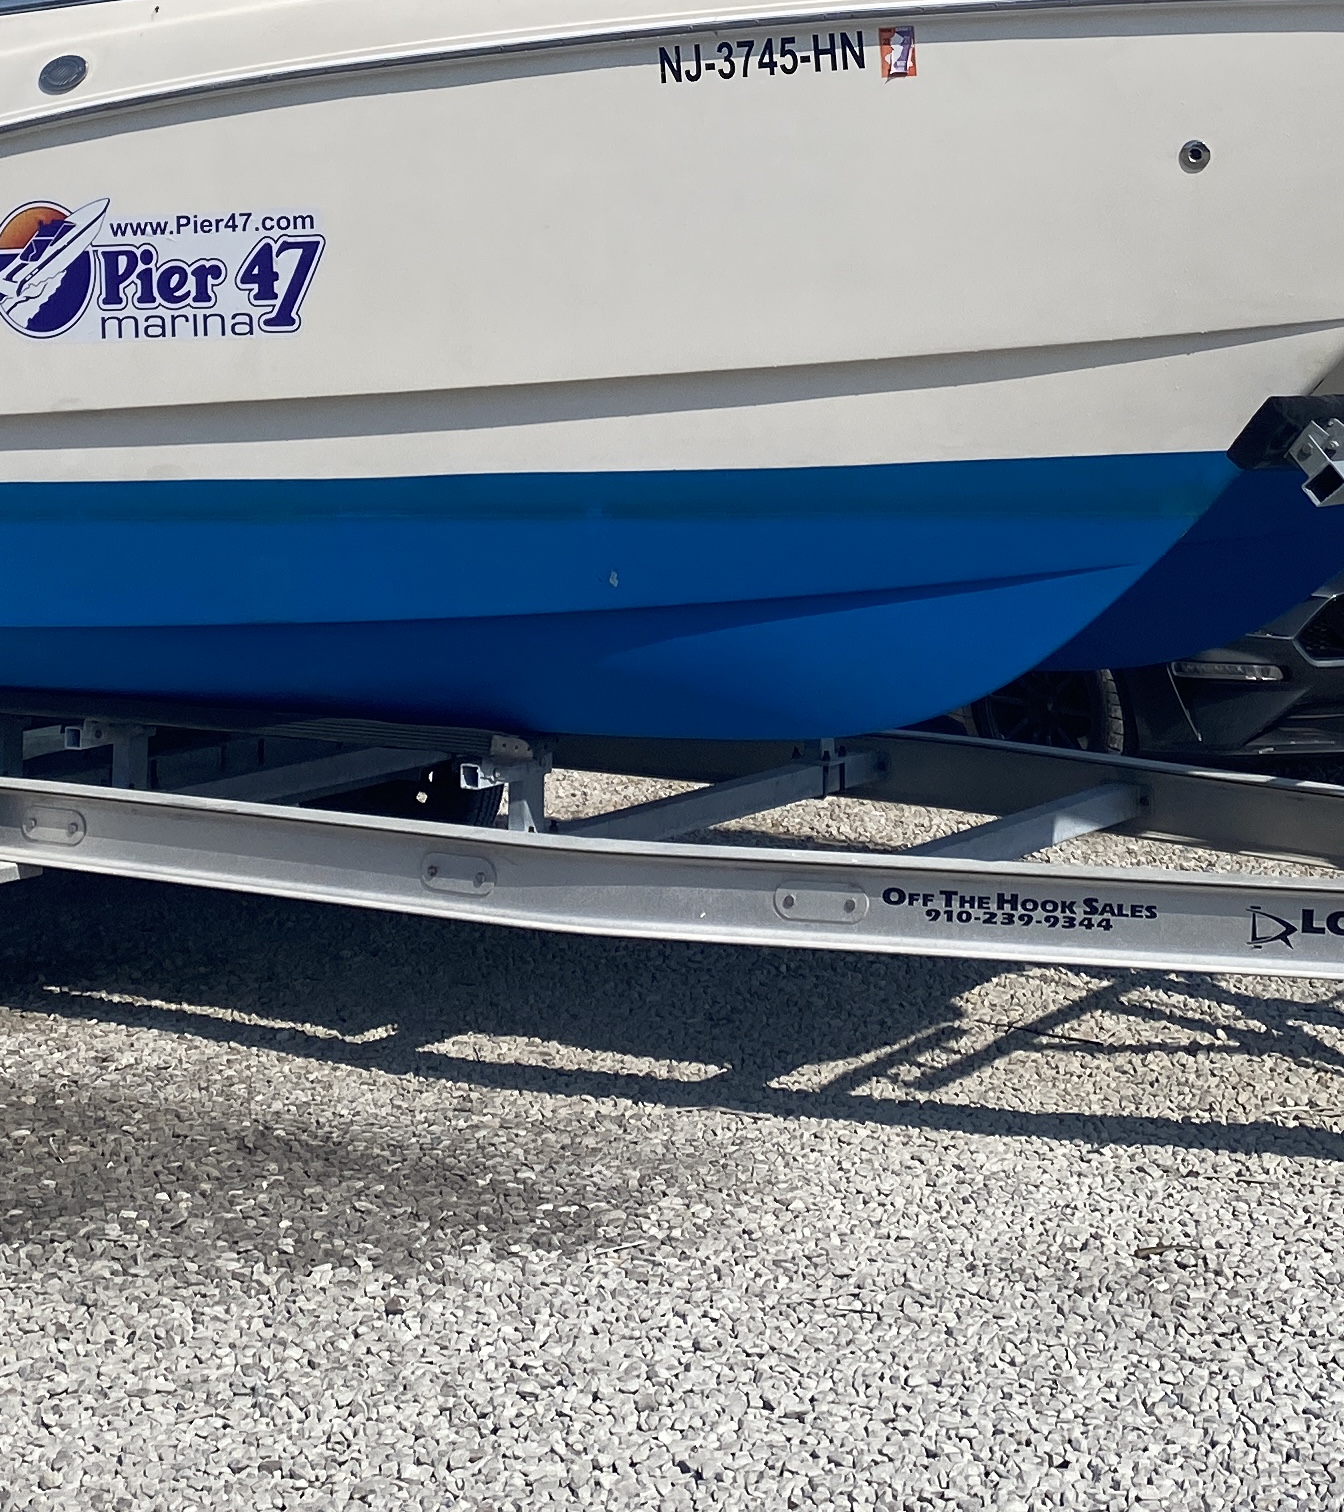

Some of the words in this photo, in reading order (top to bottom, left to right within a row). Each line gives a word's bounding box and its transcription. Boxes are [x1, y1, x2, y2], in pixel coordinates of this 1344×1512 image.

[659, 30, 866, 84] NJ-3745-HN
[109, 212, 316, 237] www.Pier47.com
[99, 248, 225, 307] Pier
[238, 238, 323, 329] 47
[100, 312, 255, 339] marina
[924, 909, 1113, 932] 910-239-9344
